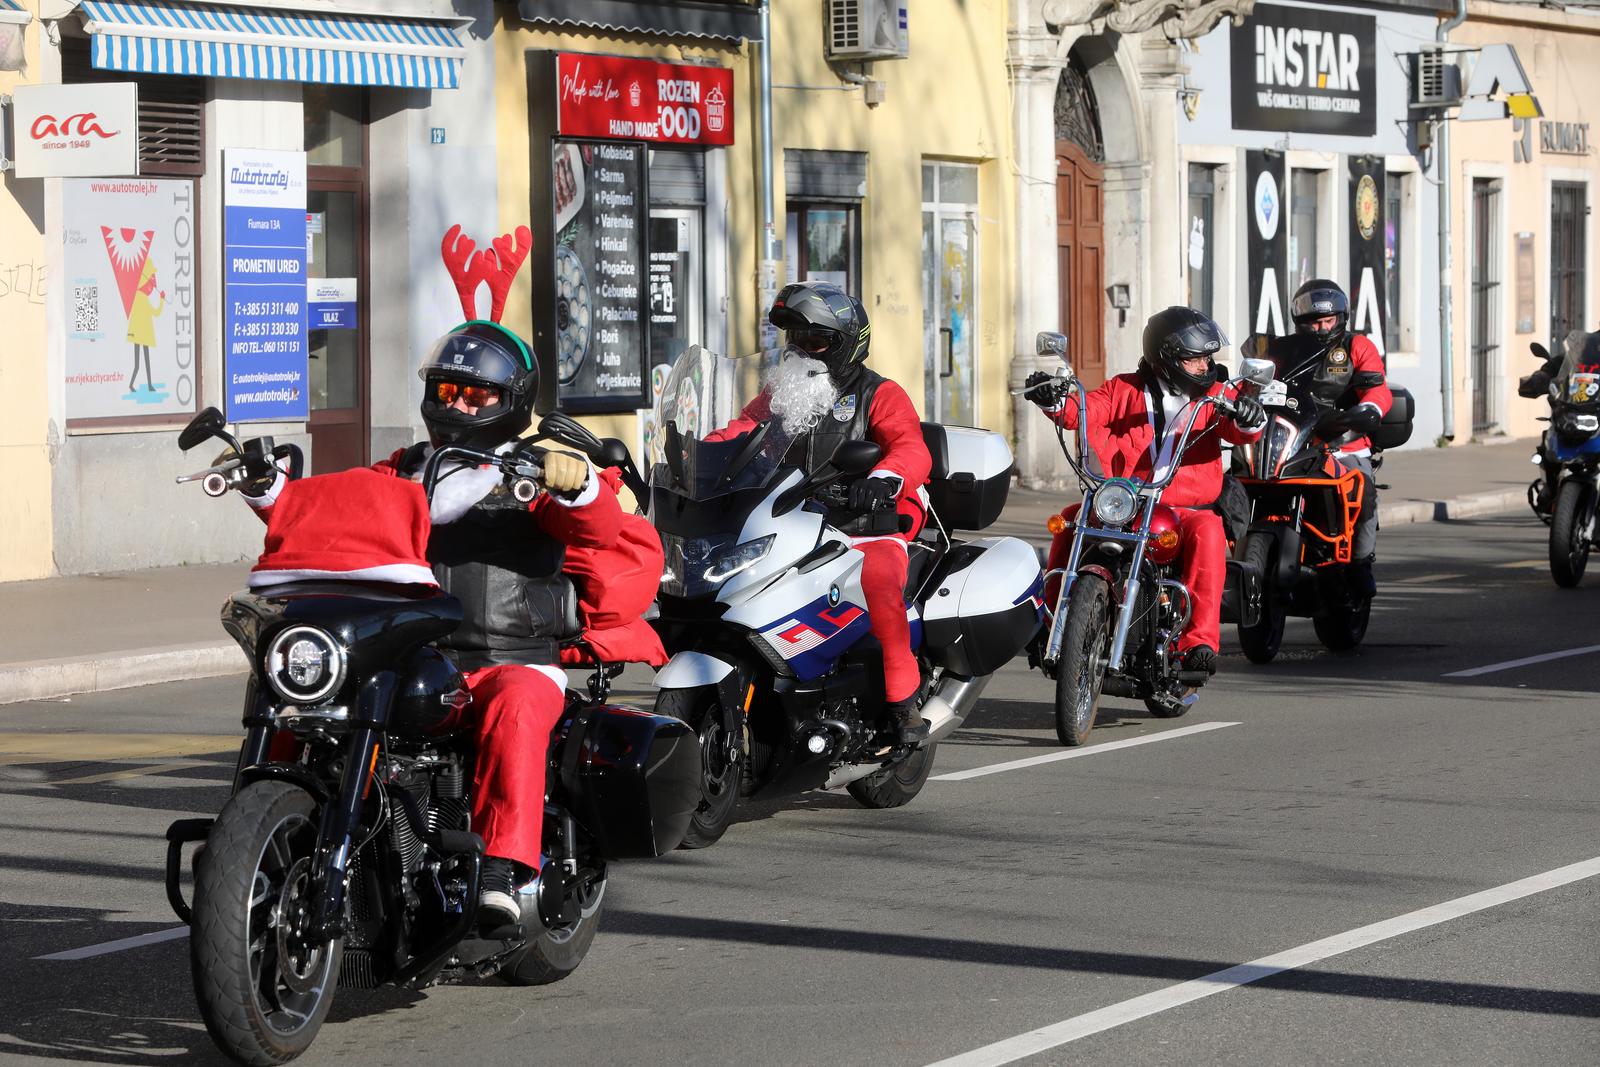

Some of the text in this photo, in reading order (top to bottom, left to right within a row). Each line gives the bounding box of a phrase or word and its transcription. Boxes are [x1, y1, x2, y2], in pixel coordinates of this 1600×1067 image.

[563, 62, 587, 105] Made
[588, 80, 603, 98] with
[31, 112, 118, 140] ara
[609, 119, 659, 138] HAND MADE
[42, 140, 66, 149] since
[600, 146, 634, 160] Kobasica
[600, 168, 625, 183] Sarma
[91, 181, 158, 196] www.autotrolej.hr
[601, 190, 633, 208] Peljmeni
[248, 219, 281, 230] Fiumara 13A
[601, 213, 634, 229] Varenike
[601, 236, 628, 251] Hinkali
[233, 258, 300, 274] PROMETNI URED
[601, 260, 635, 278] Pogačice
[173, 185, 193, 406] TORPEDO
[601, 280, 637, 298] Čebureke
[234, 302, 299, 315] T: +385 51 311 400
[601, 306, 638, 321] Palačinke
[323, 312, 339, 323] ULAZ
[234, 323, 299, 336] F: +385 51 330 330
[601, 328, 619, 343] Borš
[232, 342, 248, 354] INFO
[264, 341, 276, 352] 060
[277, 341, 287, 352] 151
[289, 341, 300, 352] 151
[602, 352, 620, 366] Juha
[600, 373, 641, 391] Pljeskavice
